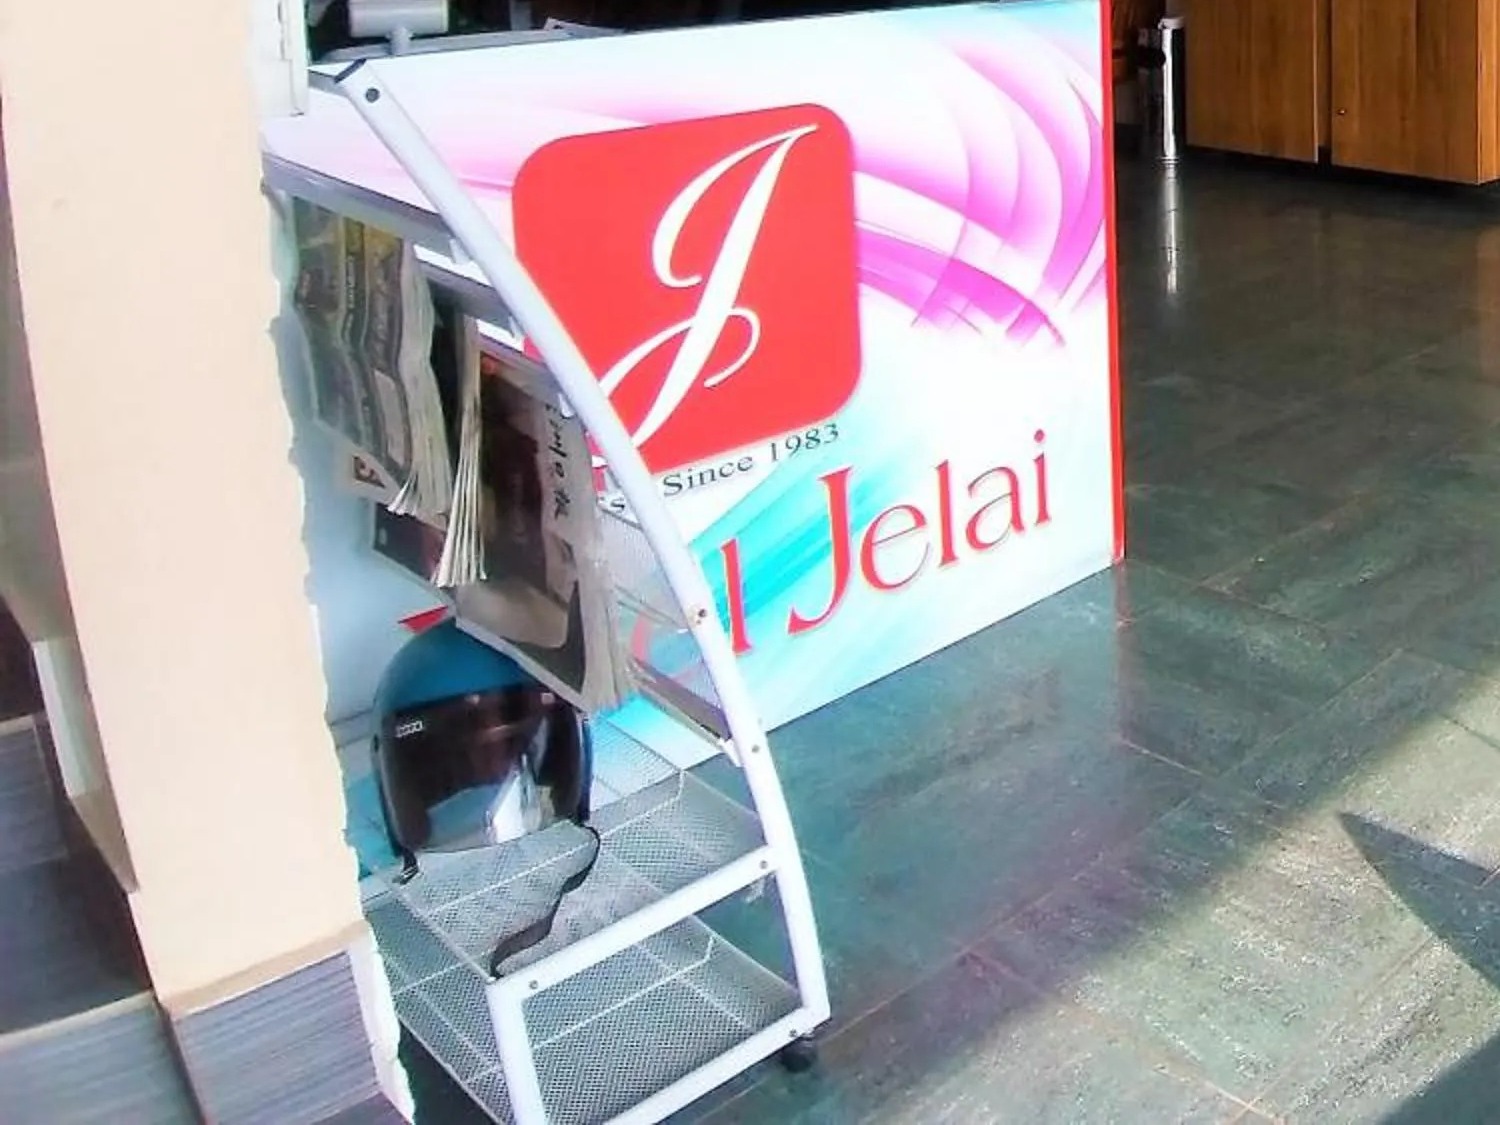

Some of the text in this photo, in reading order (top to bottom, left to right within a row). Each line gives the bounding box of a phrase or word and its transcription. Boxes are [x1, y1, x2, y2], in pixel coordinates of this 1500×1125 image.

[662, 422, 839, 497] Since 1983
[787, 427, 1053, 637] Jelai
